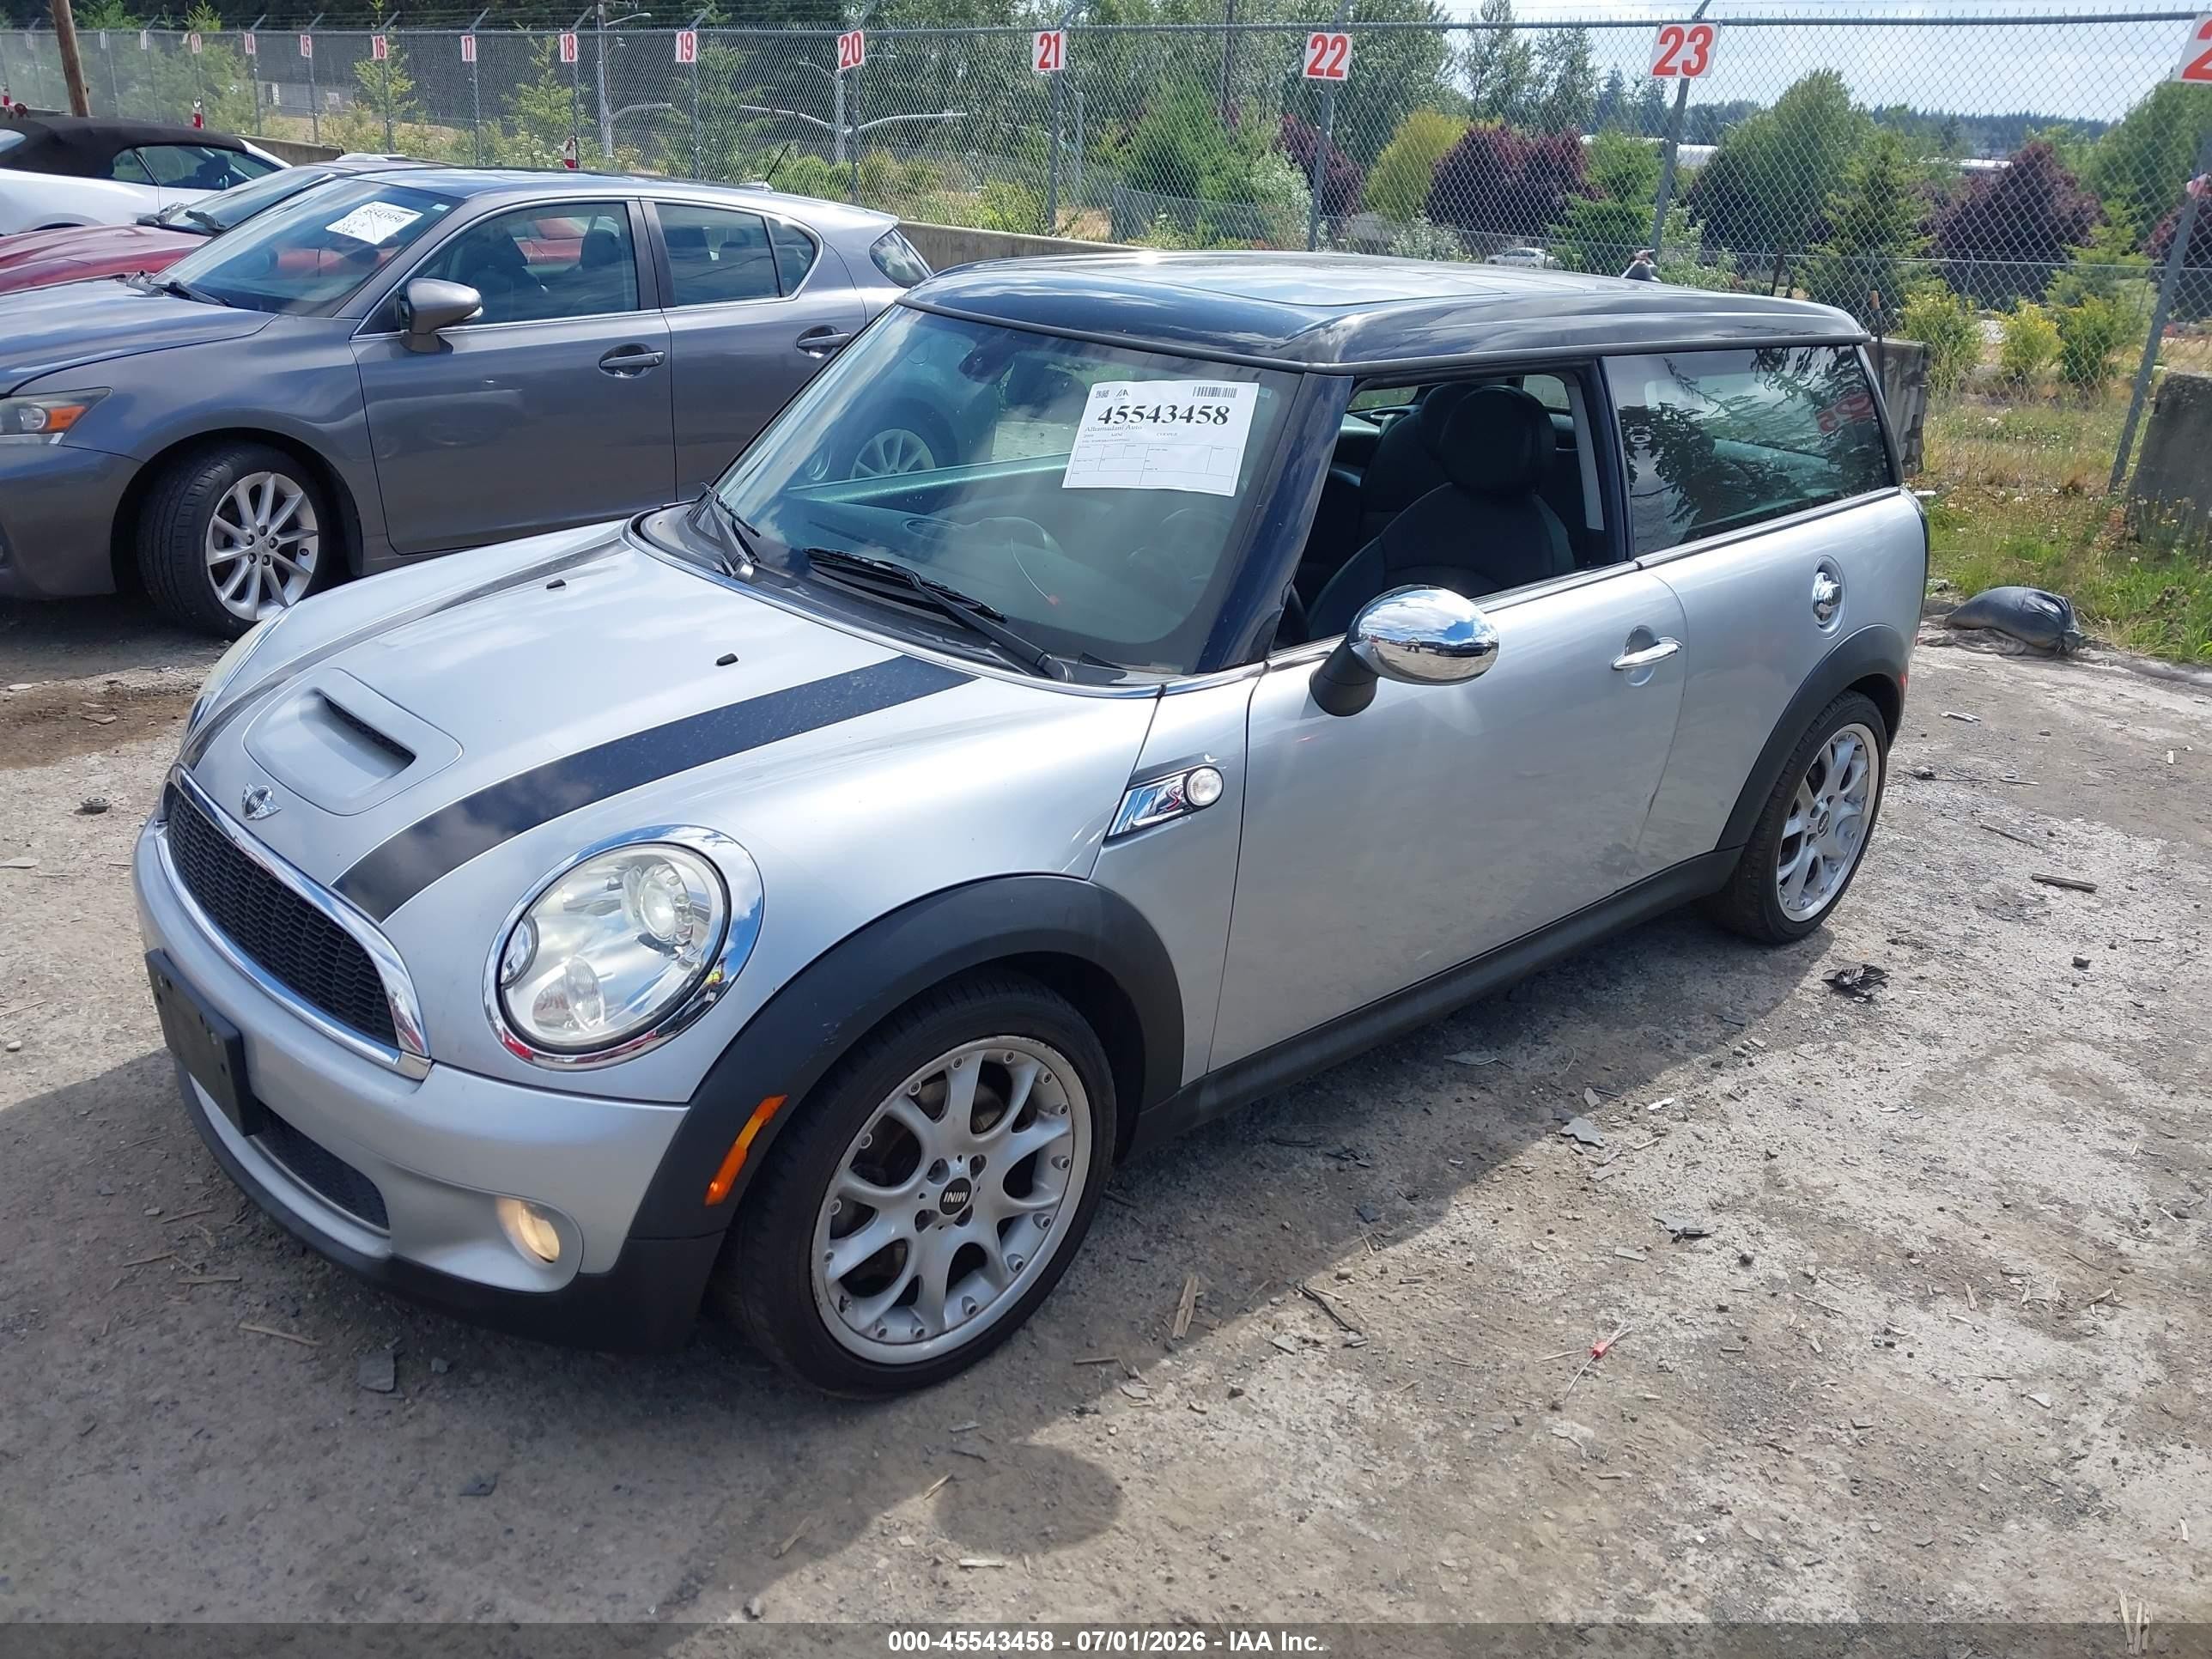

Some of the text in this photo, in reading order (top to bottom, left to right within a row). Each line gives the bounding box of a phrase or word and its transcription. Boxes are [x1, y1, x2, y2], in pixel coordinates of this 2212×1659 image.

[301, 36, 310, 55] 15
[374, 37, 386, 58] 16
[463, 37, 473, 60] 17
[562, 35, 574, 61] 18
[678, 33, 693, 61] 19
[840, 32, 862, 68] 20
[1038, 33, 1060, 69] 21
[1306, 34, 1349, 77] 22
[1652, 26, 1714, 76] 23
[1097, 404, 1230, 426] 45543458
[943, 1191, 968, 1203] MINI
